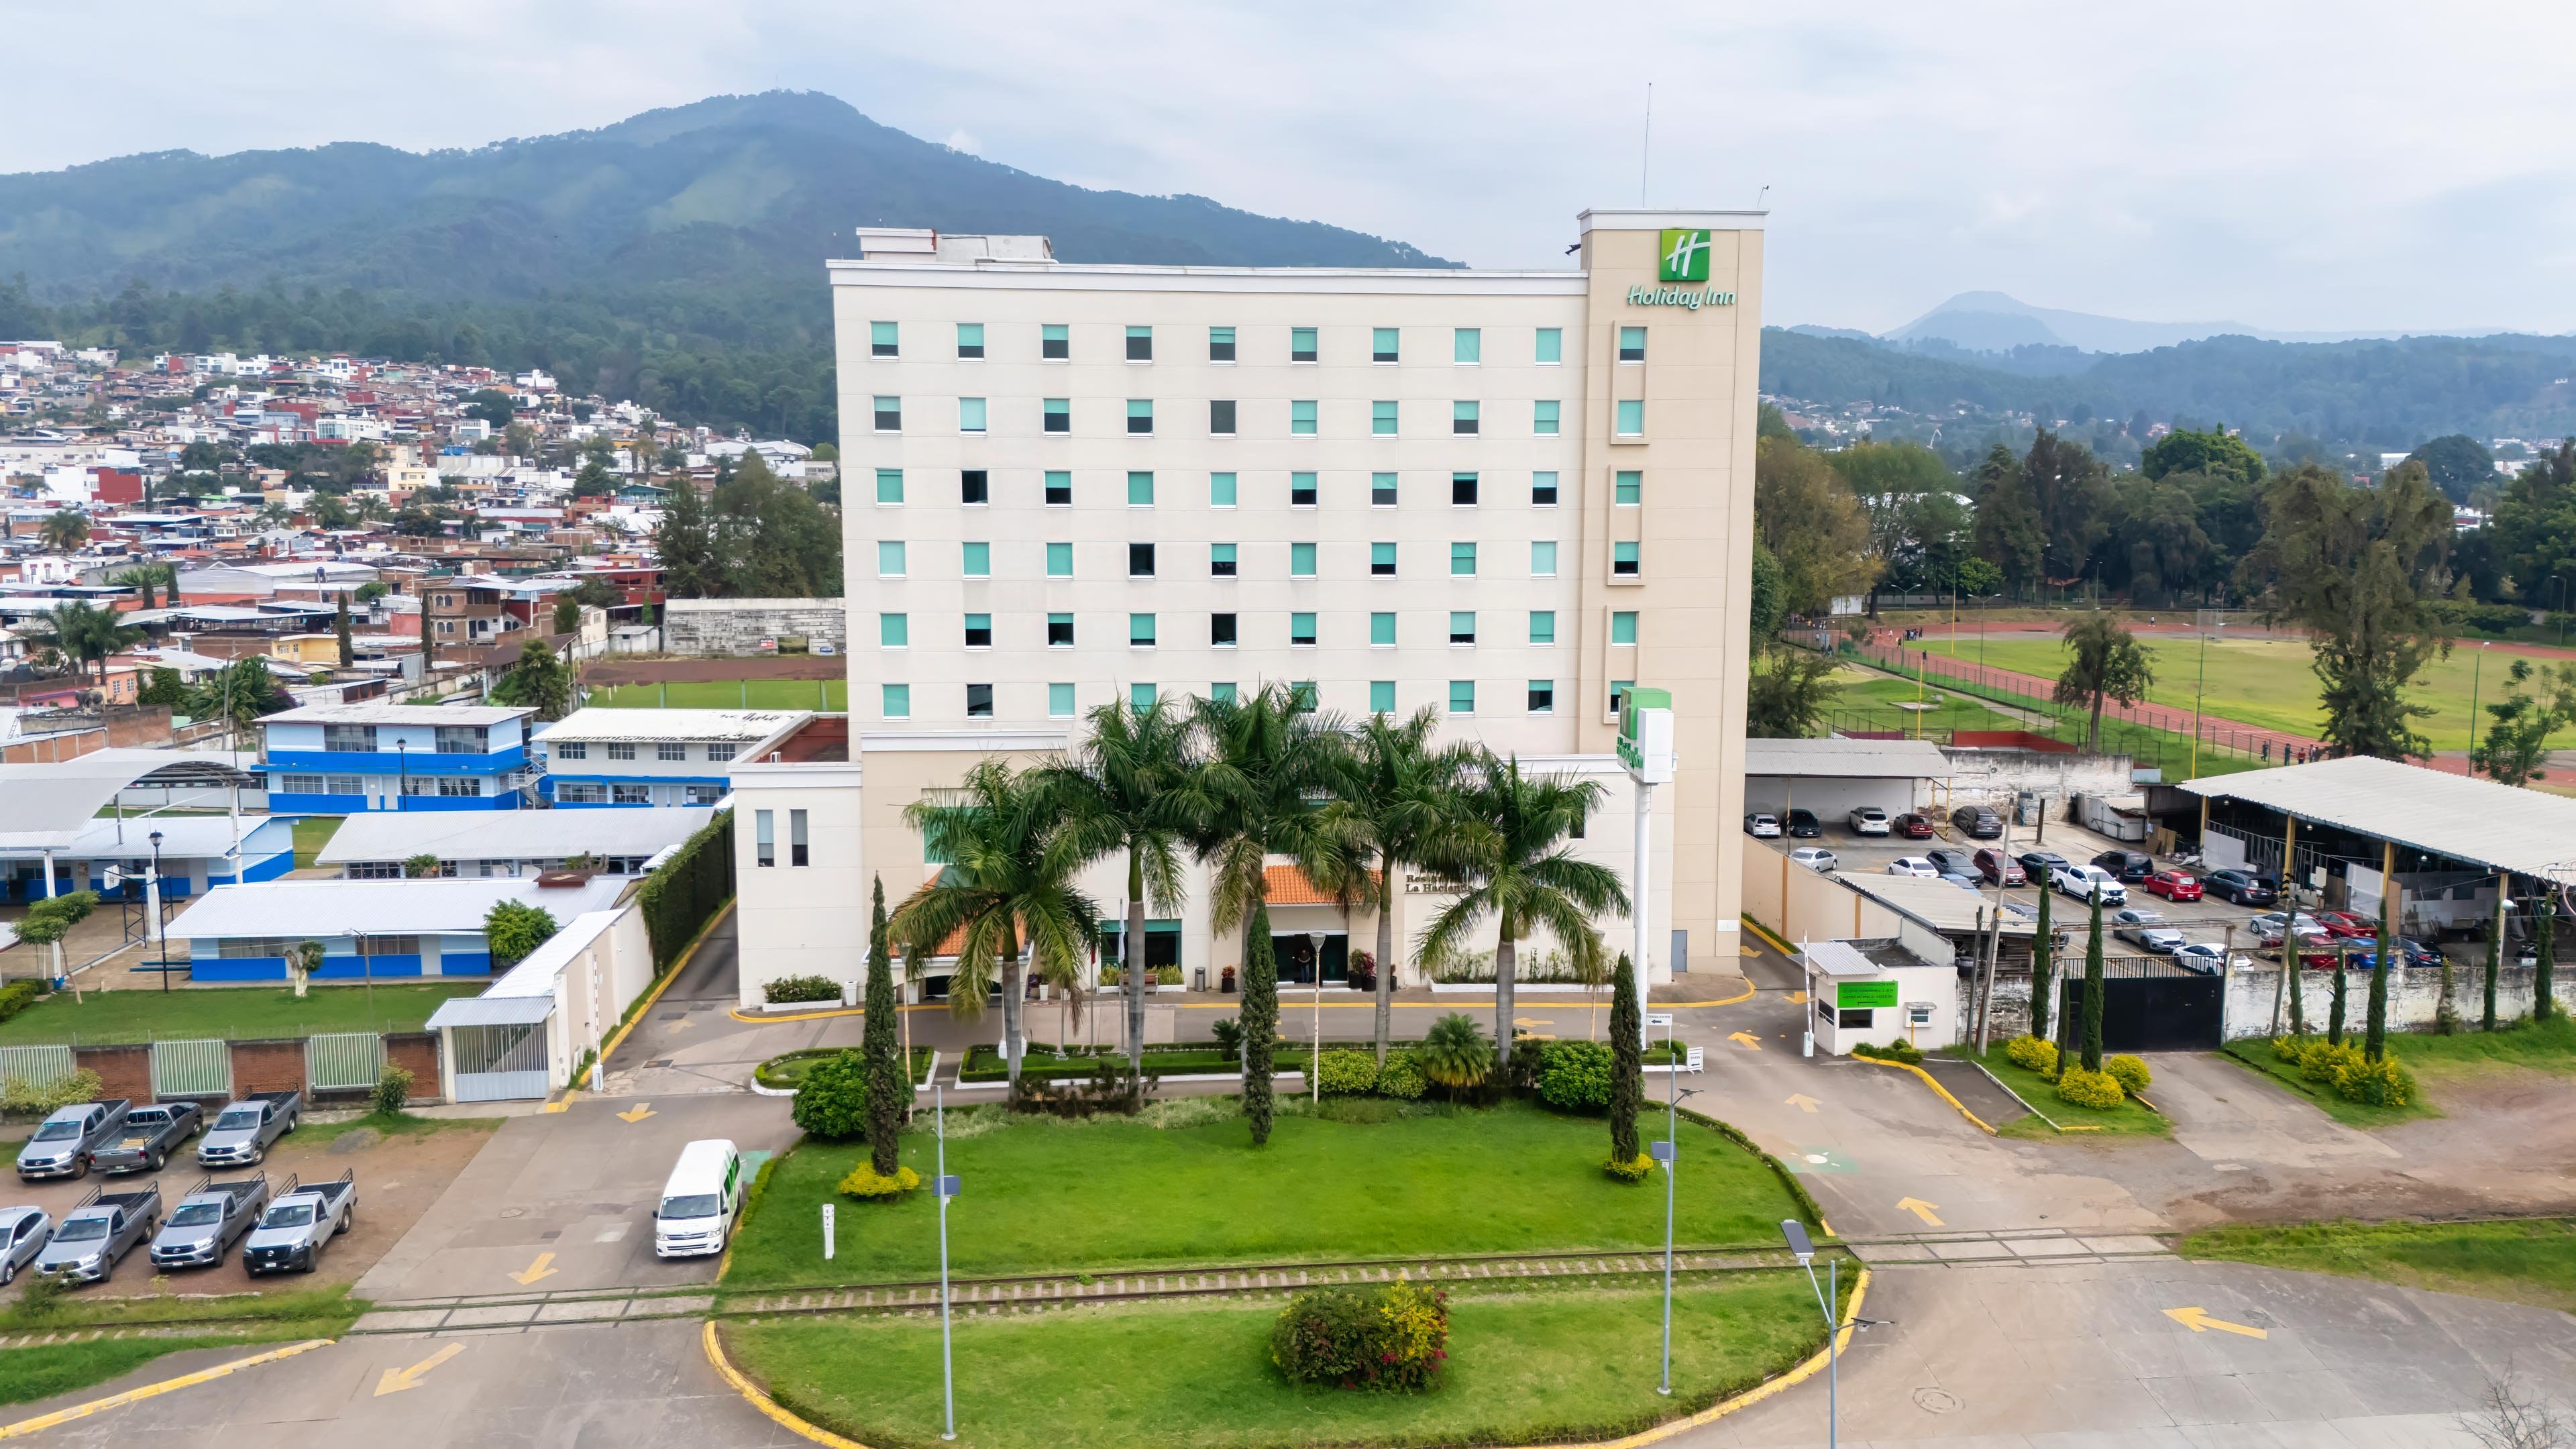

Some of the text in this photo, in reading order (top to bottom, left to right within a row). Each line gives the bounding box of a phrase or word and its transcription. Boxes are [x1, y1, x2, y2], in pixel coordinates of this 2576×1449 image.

[1627, 284, 1736, 310] Holiday Inn
[1405, 883, 1420, 893] La
